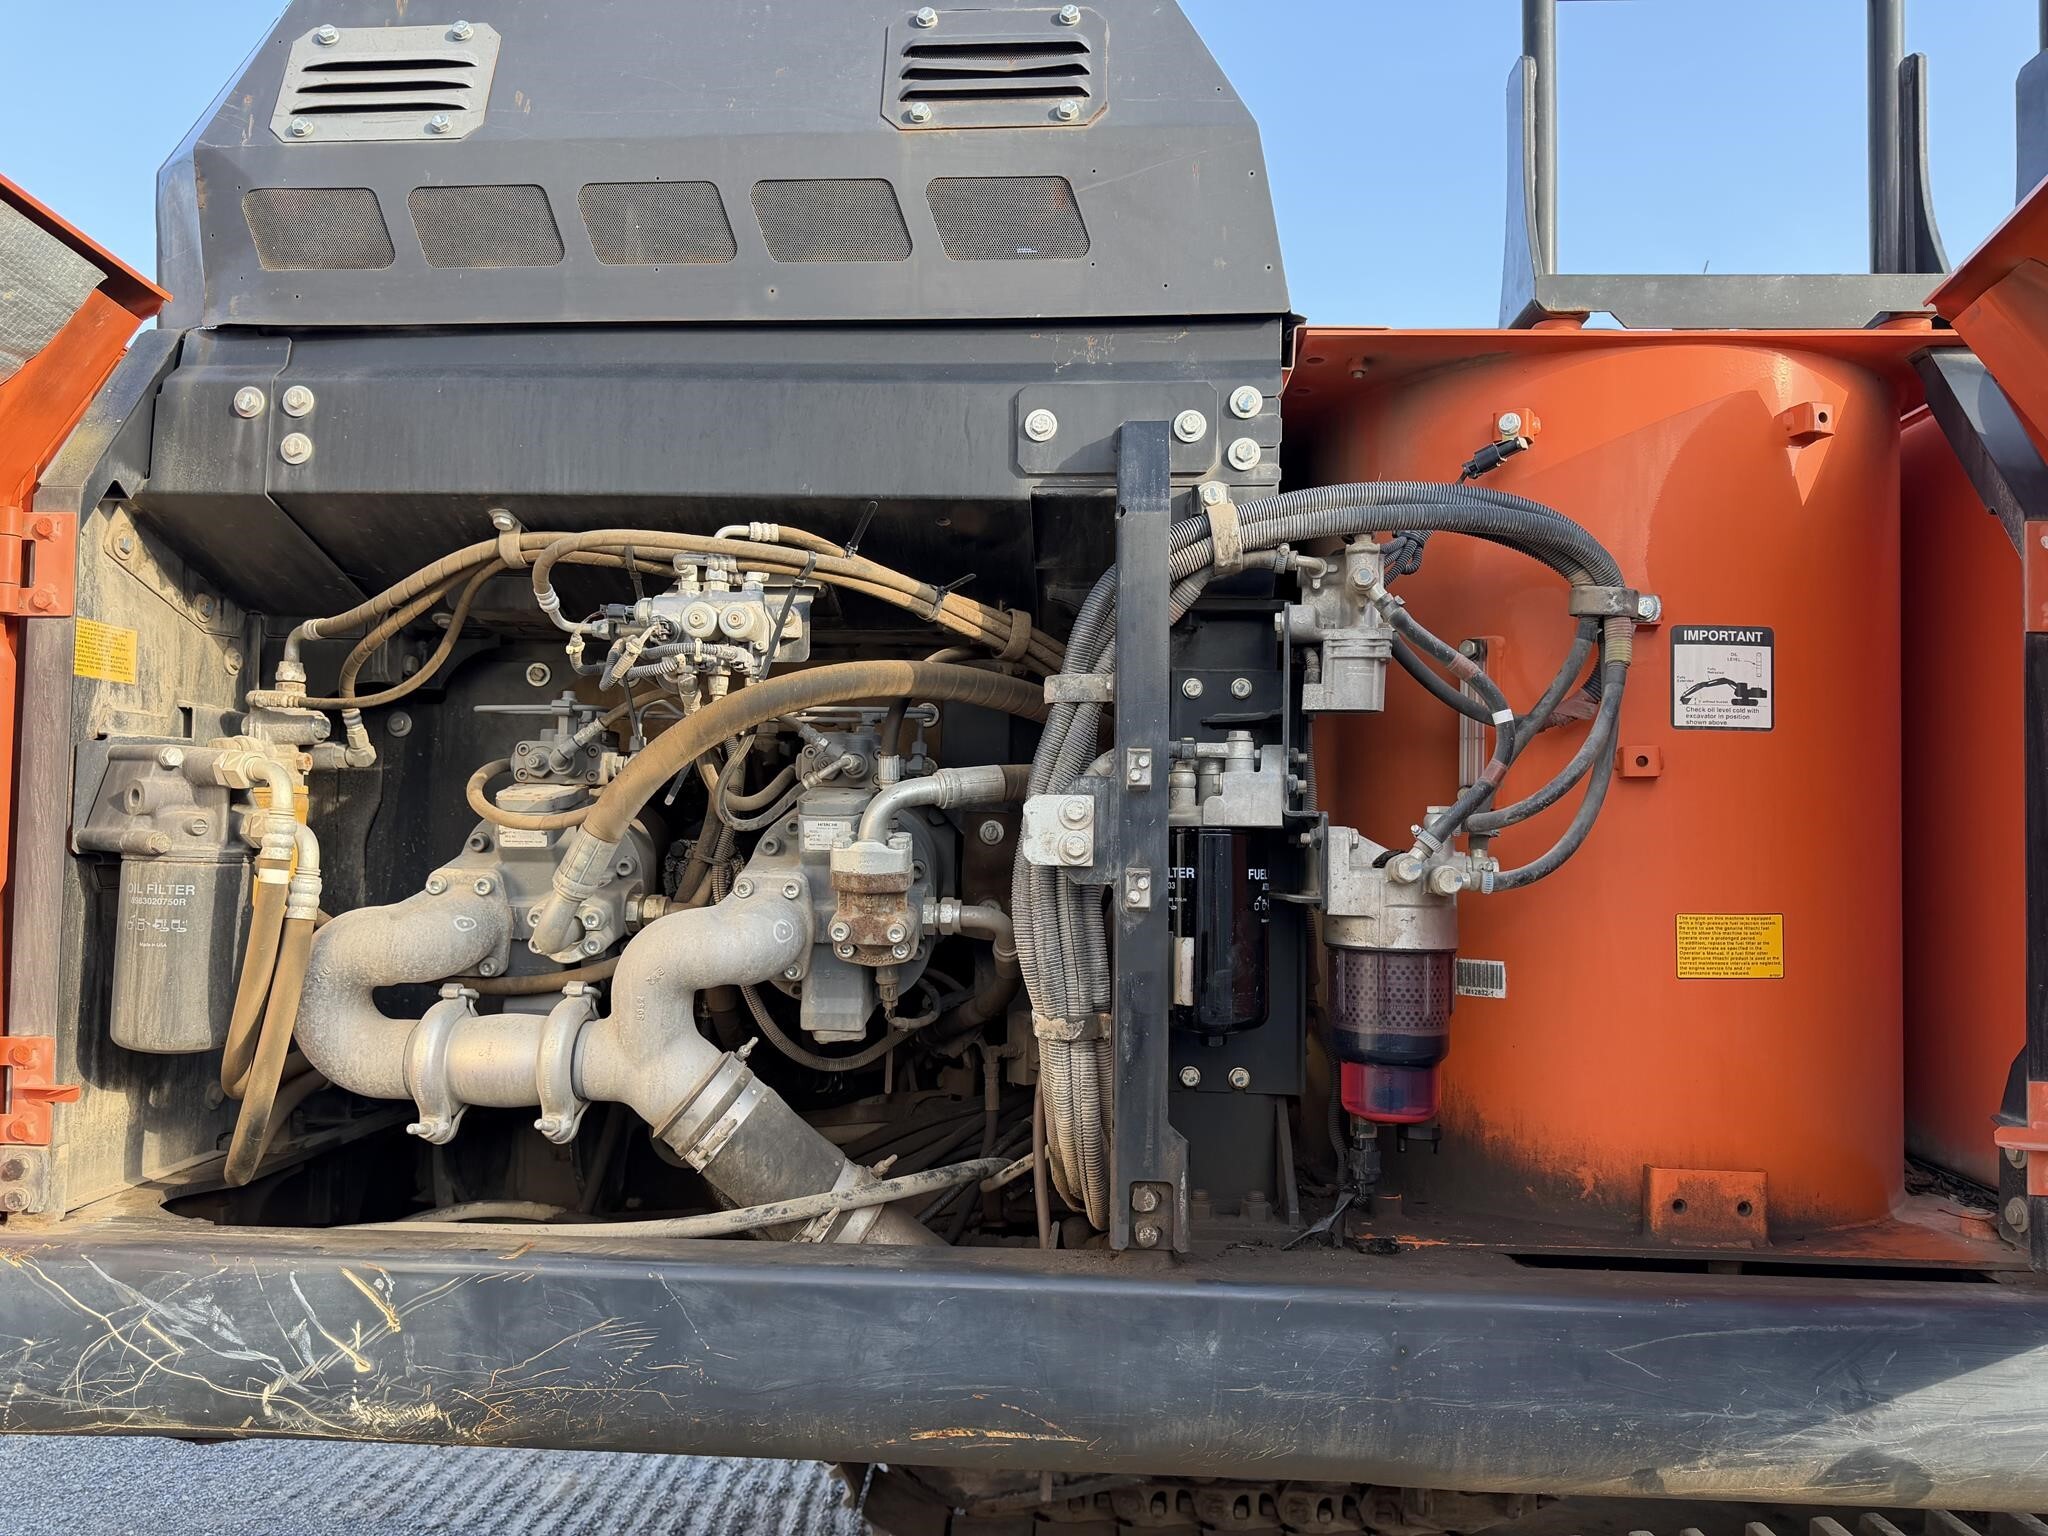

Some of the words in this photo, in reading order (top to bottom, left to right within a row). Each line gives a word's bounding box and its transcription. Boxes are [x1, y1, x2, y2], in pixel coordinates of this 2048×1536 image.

[1684, 630, 1763, 642] IMPORTANT
[1168, 868, 1195, 878] LTER
[1248, 869, 1268, 880] FUEL
[128, 883, 143, 894] OIL
[146, 884, 196, 896] FILTER
